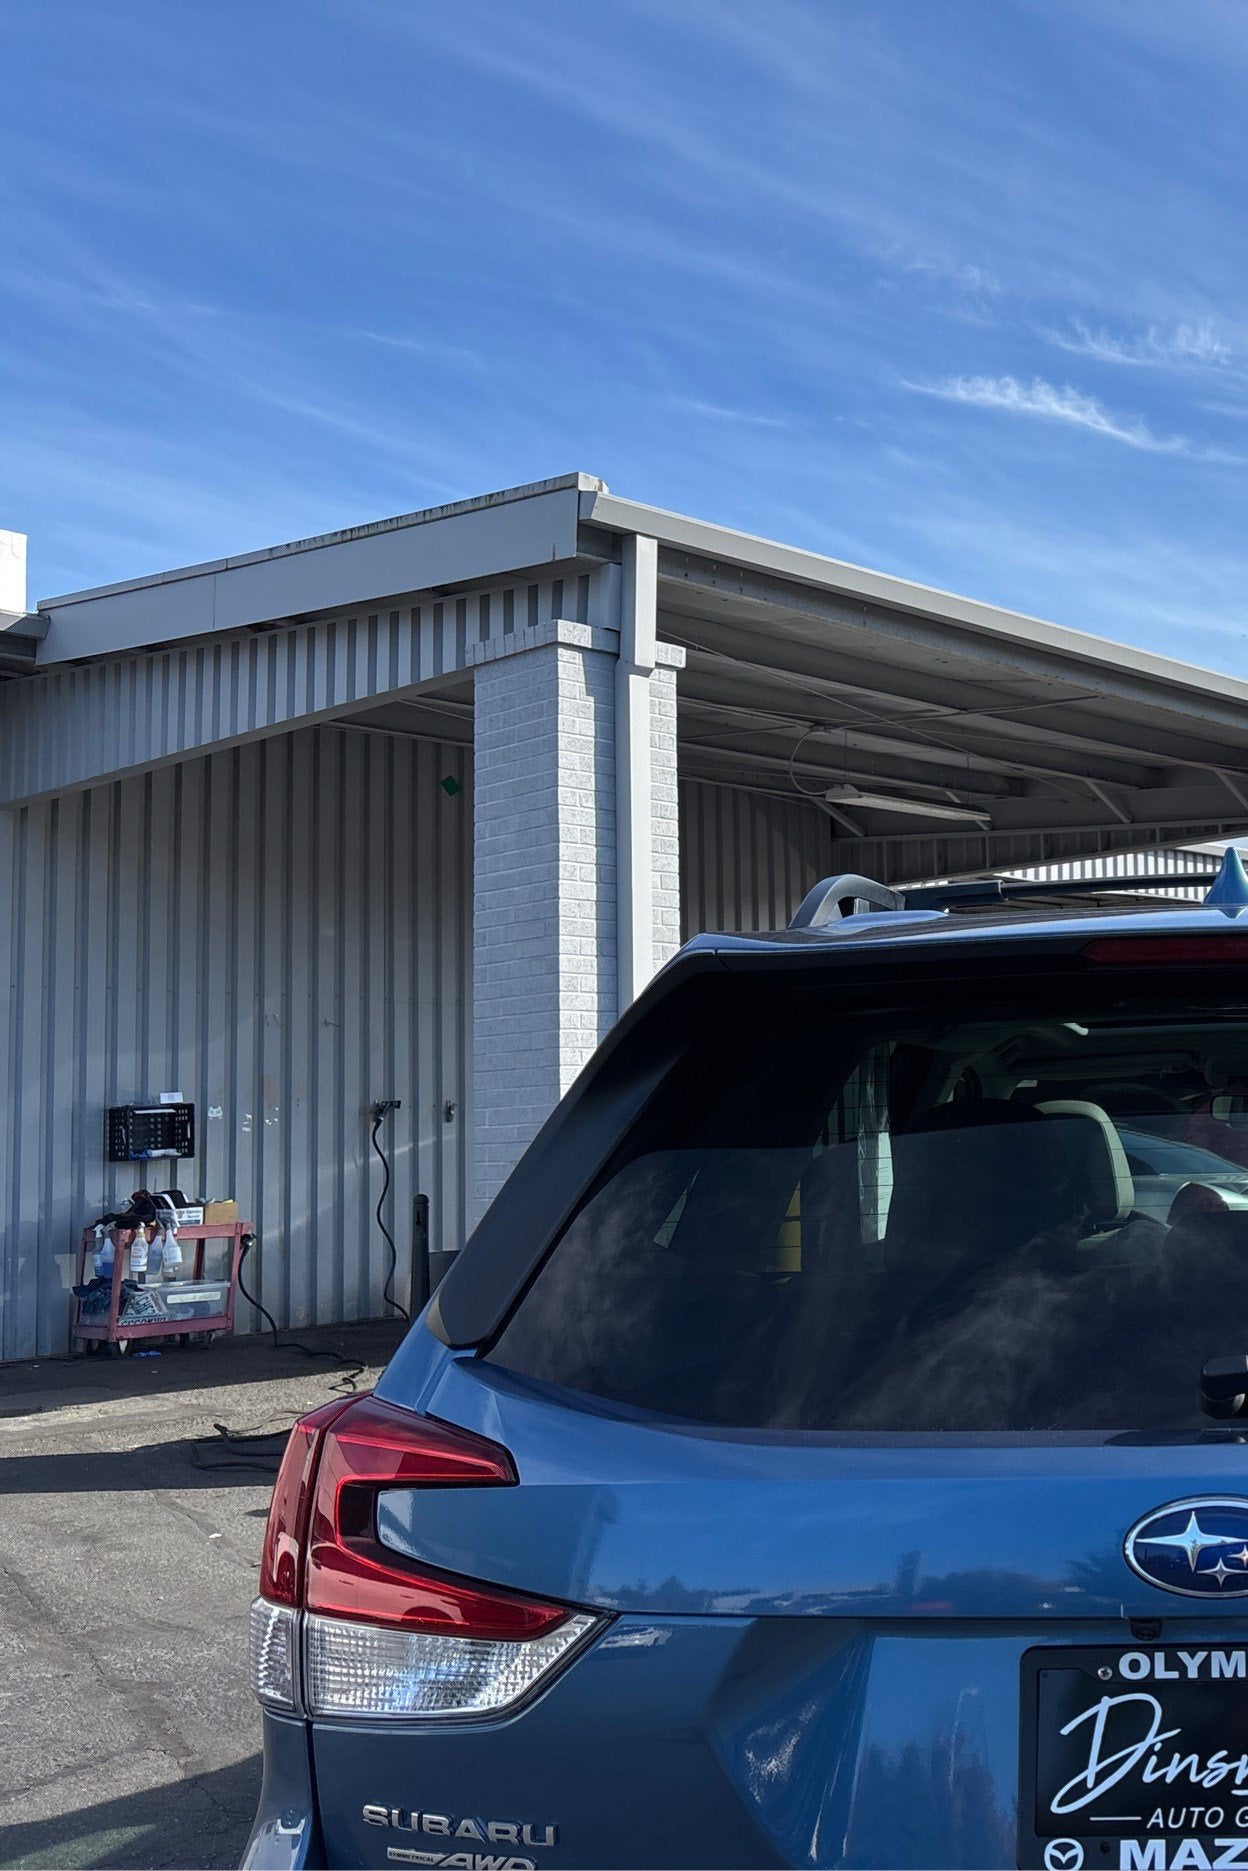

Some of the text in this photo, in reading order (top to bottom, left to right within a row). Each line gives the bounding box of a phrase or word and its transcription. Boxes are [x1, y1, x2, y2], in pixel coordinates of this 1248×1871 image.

[362, 1804, 556, 1848] SUBARU
[1146, 1807, 1224, 1830] AUTO
[388, 1851, 536, 1870] SYMMETRICAL AWD
